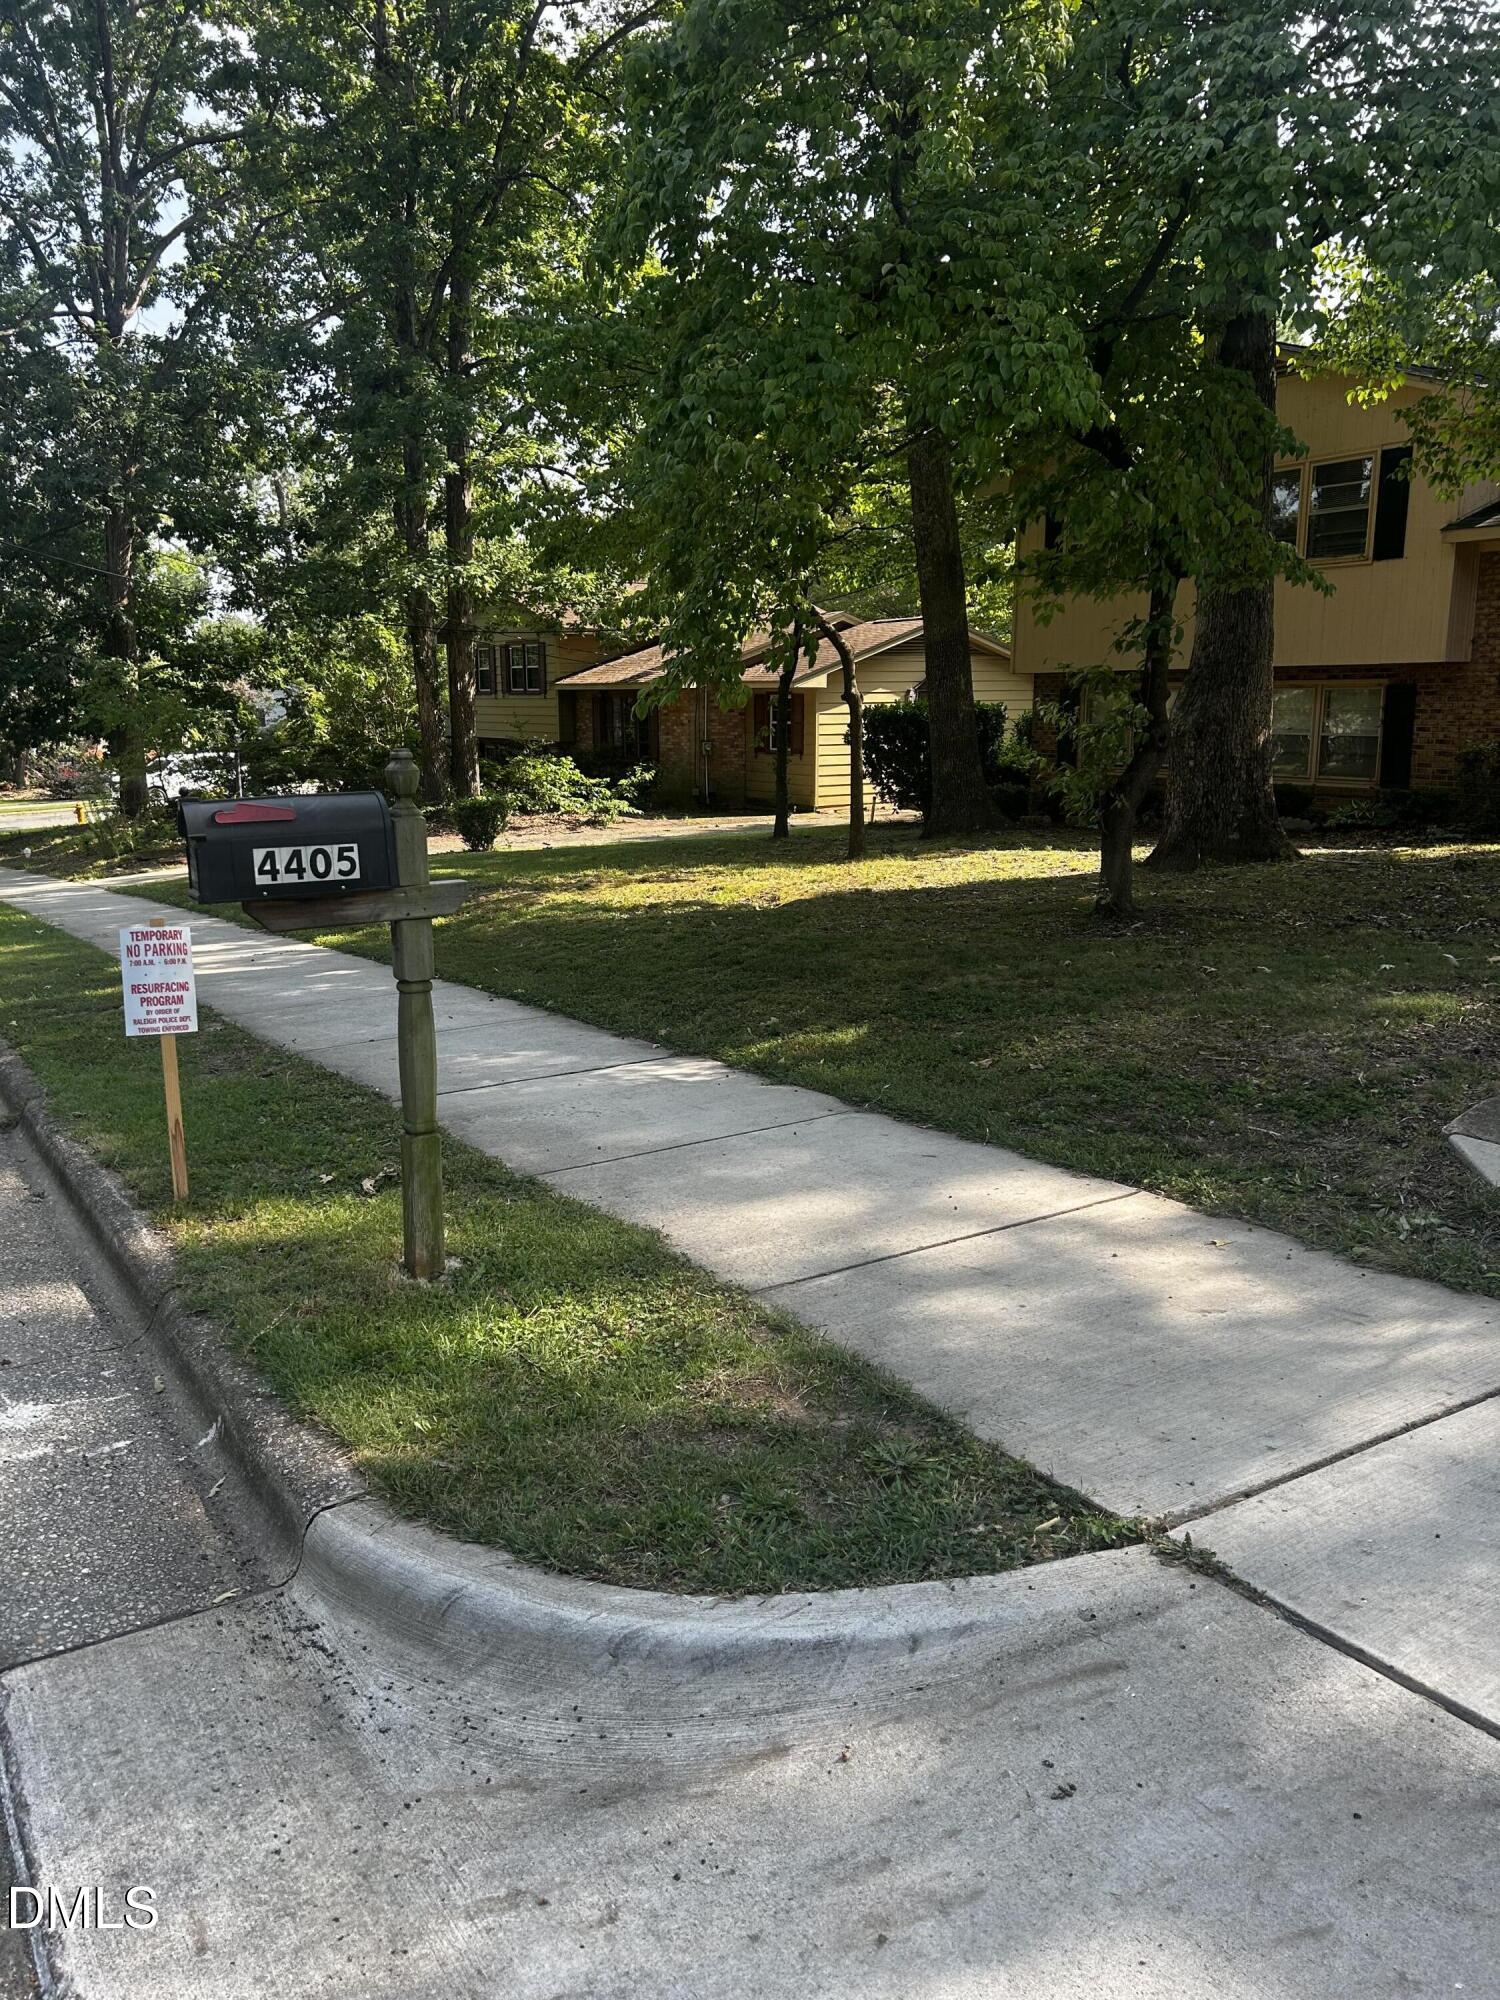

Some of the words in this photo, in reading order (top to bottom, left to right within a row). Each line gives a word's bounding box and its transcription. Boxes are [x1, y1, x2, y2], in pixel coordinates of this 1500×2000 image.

[258, 846, 356, 881] 4405
[130, 930, 182, 941] TEMPORARY
[126, 944, 140, 958] NO
[145, 943, 188, 956] PARKING
[131, 982, 189, 994] RESURFACING
[140, 995, 183, 1007] PROGRAM
